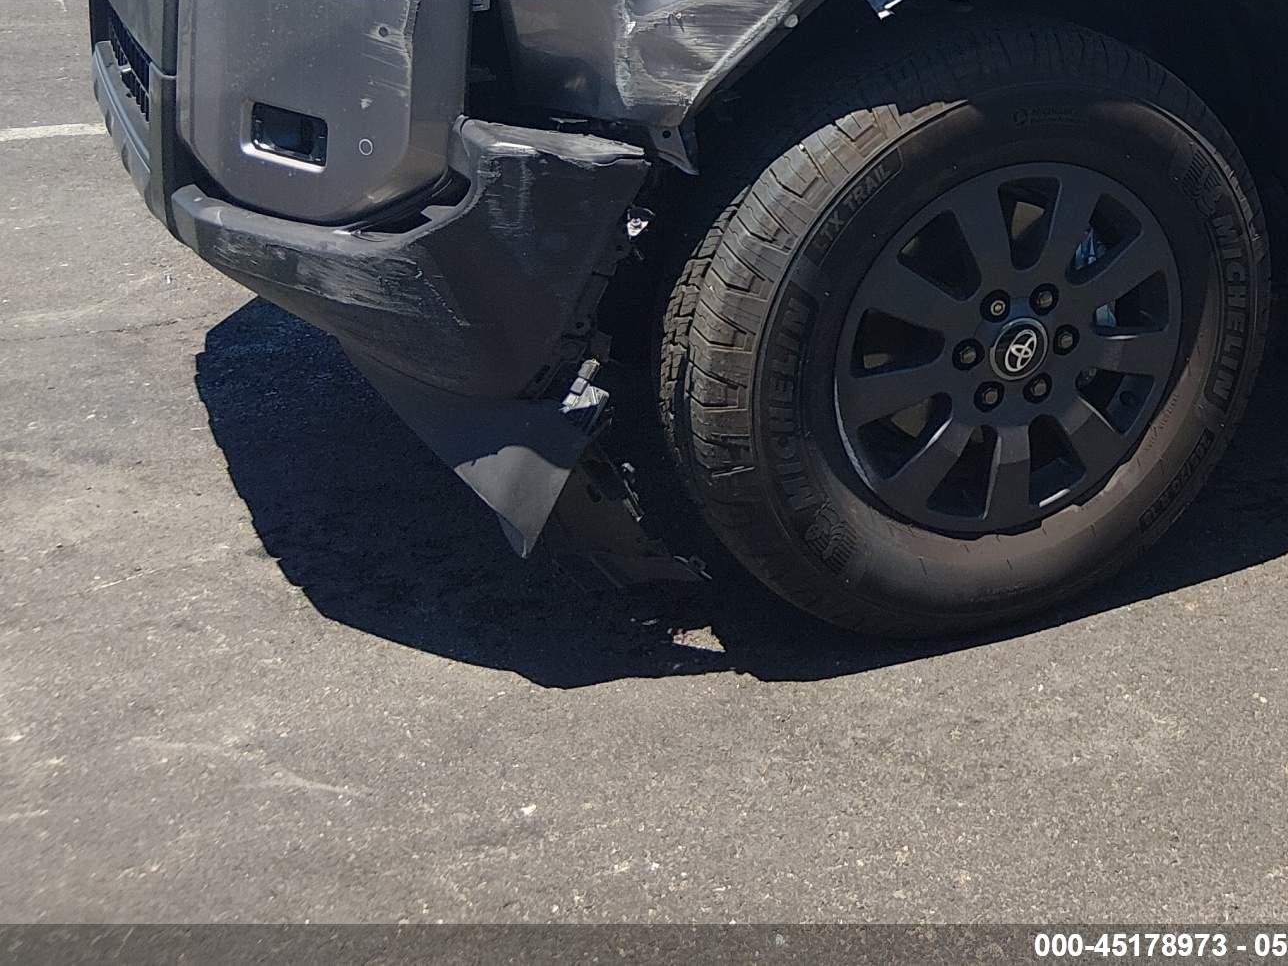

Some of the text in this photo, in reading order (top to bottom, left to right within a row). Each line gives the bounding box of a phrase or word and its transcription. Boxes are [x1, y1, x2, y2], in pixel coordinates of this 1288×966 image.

[843, 164, 890, 211] TRAIL
[768, 296, 818, 509] MICHELIN
[1213, 214, 1250, 406] MICHELIN
